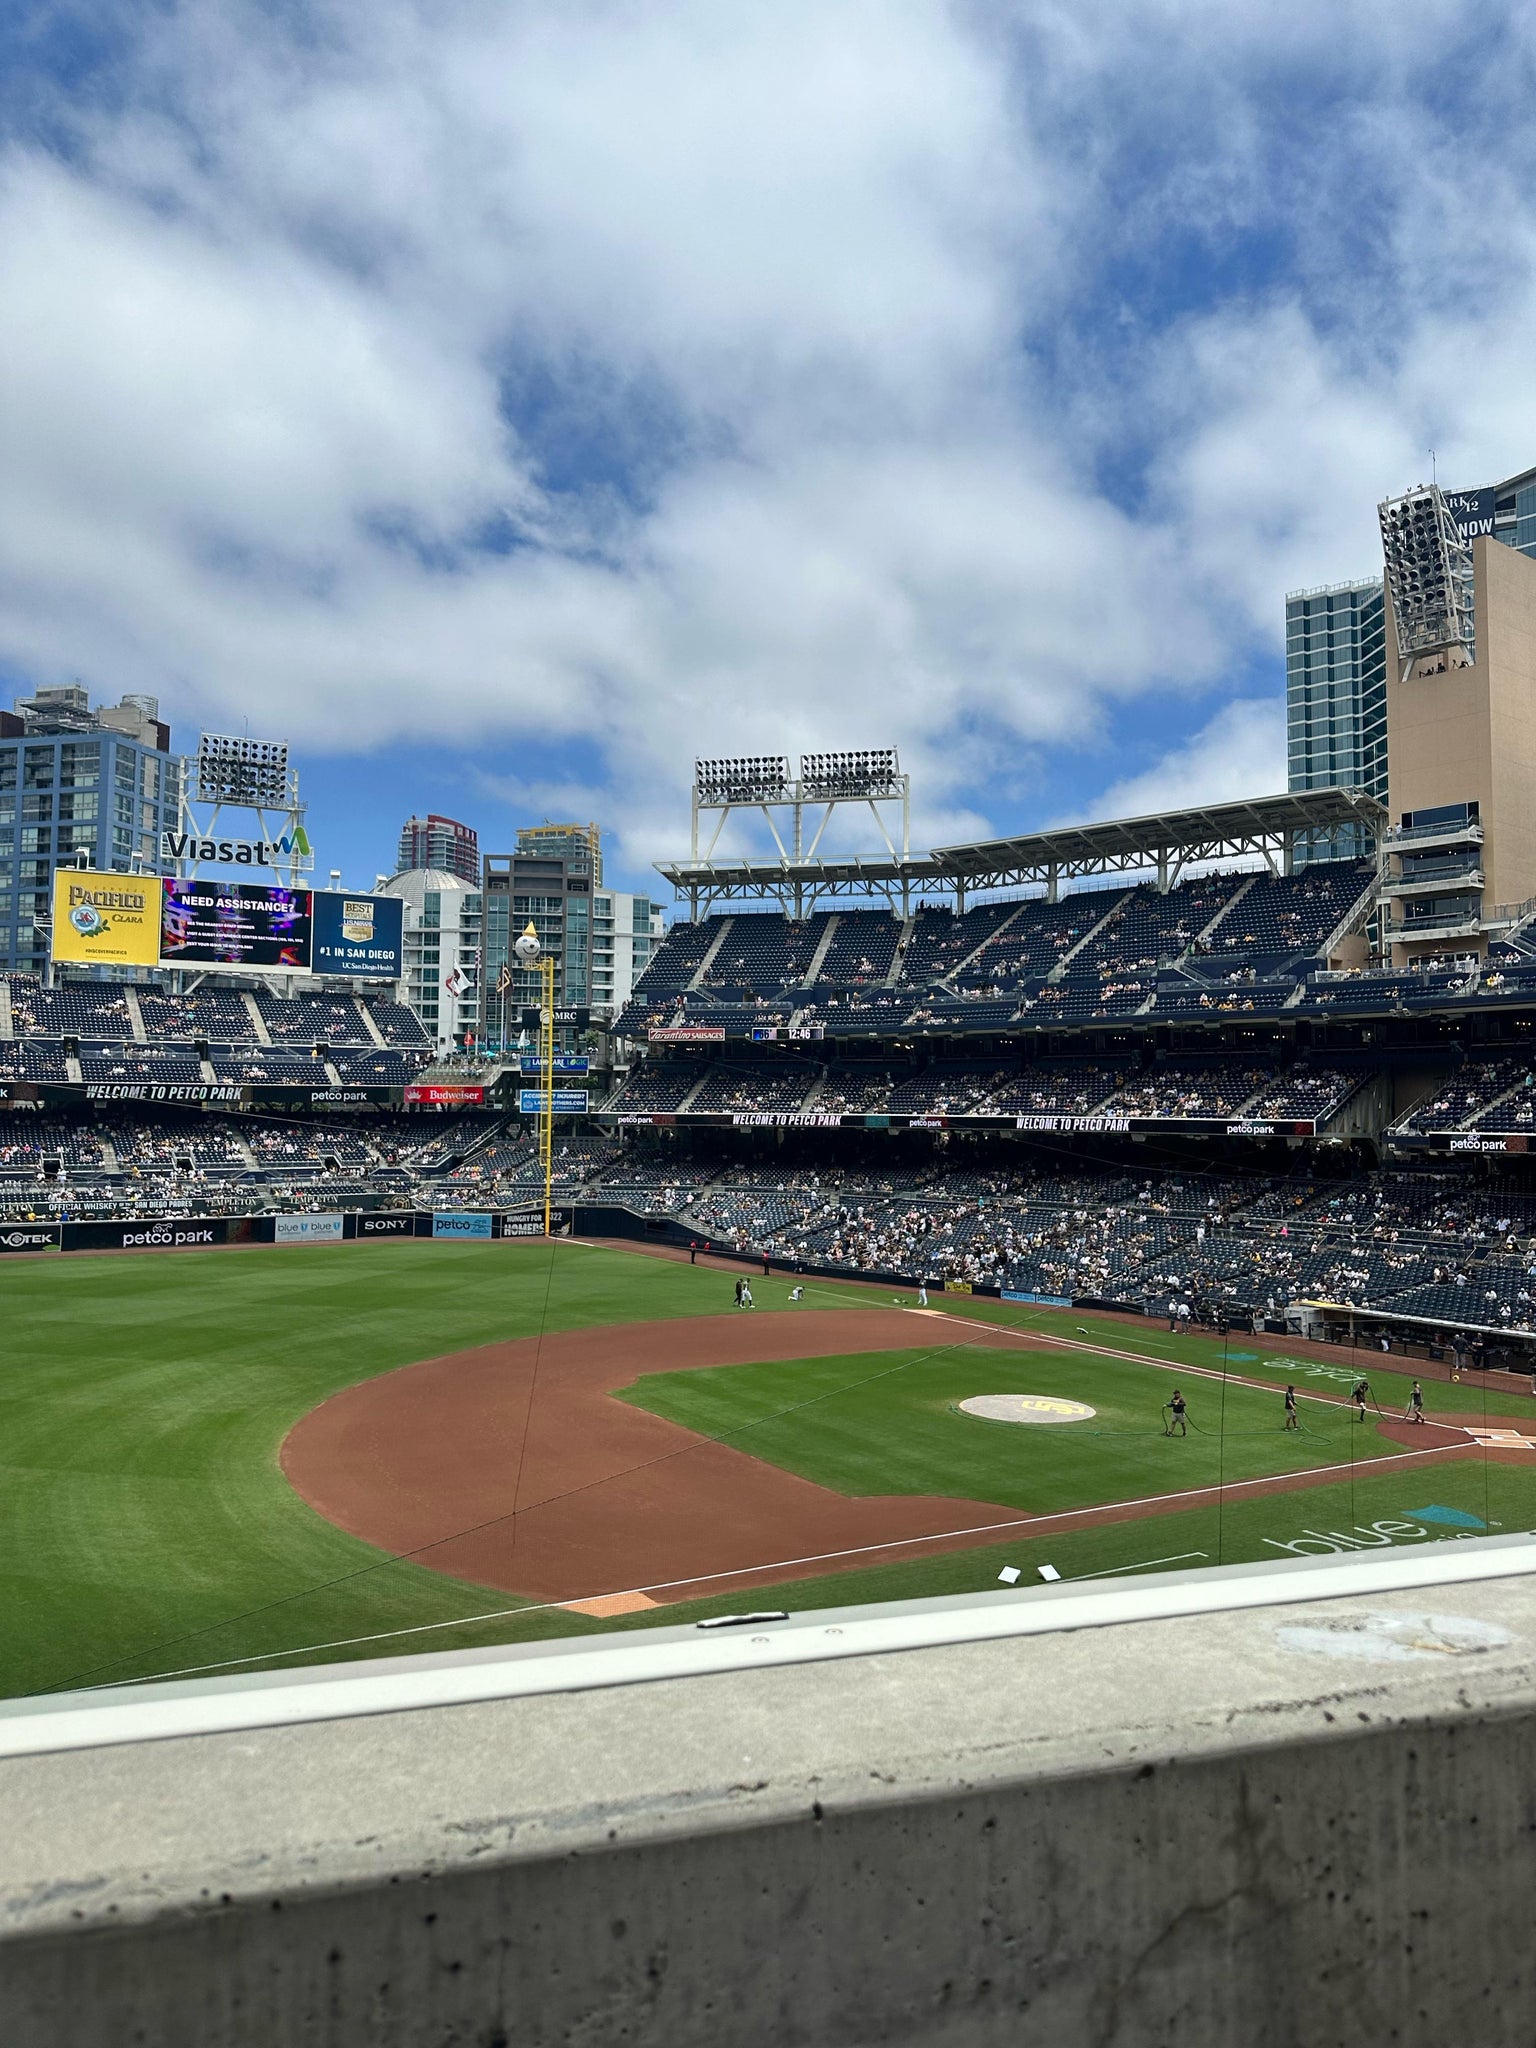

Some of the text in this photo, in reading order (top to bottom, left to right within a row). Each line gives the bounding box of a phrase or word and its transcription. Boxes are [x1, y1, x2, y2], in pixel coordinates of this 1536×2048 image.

[1459, 518, 1493, 537] NOW
[166, 832, 269, 865] Viasat
[69, 885, 145, 908] PACIFICO
[181, 895, 295, 912] NEED ASSISTANCE?
[345, 903, 372, 913] BEST
[112, 914, 143, 923] CLARA
[320, 946, 395, 960] #1 IN SAN DIEGO
[651, 1030, 690, 1040] Tarantino
[788, 1029, 810, 1039] 12:46
[86, 1085, 244, 1100] WELCOME TO PETCO PARK
[311, 1090, 367, 1102] petco park
[429, 1090, 479, 1100] Budweiser
[617, 1116, 653, 1125] petco park
[732, 1115, 842, 1126] WELCOME TO PETCO PARK
[909, 1119, 942, 1127] petco park
[1016, 1118, 1131, 1131] WELCOME TO PETCO PARK
[1226, 1124, 1274, 1135] petco park
[1450, 1137, 1507, 1151] petco park
[48, 1203, 82, 1211] OFFICIAL
[83, 1202, 118, 1210] WHISKEY
[168, 1200, 193, 1208] PADRES
[506, 1214, 542, 1223] HUNGRY FOR
[550, 1212, 562, 1221] 322
[311, 1222, 331, 1230] blue
[364, 1220, 407, 1230] SONY
[436, 1220, 470, 1231] petco
[503, 1222, 544, 1236] HOMERS
[123, 1229, 213, 1248] petco park
[1001, 1290, 1018, 1298] petco
[1037, 1295, 1054, 1303] petco
[1261, 1520, 1428, 1556] blue
